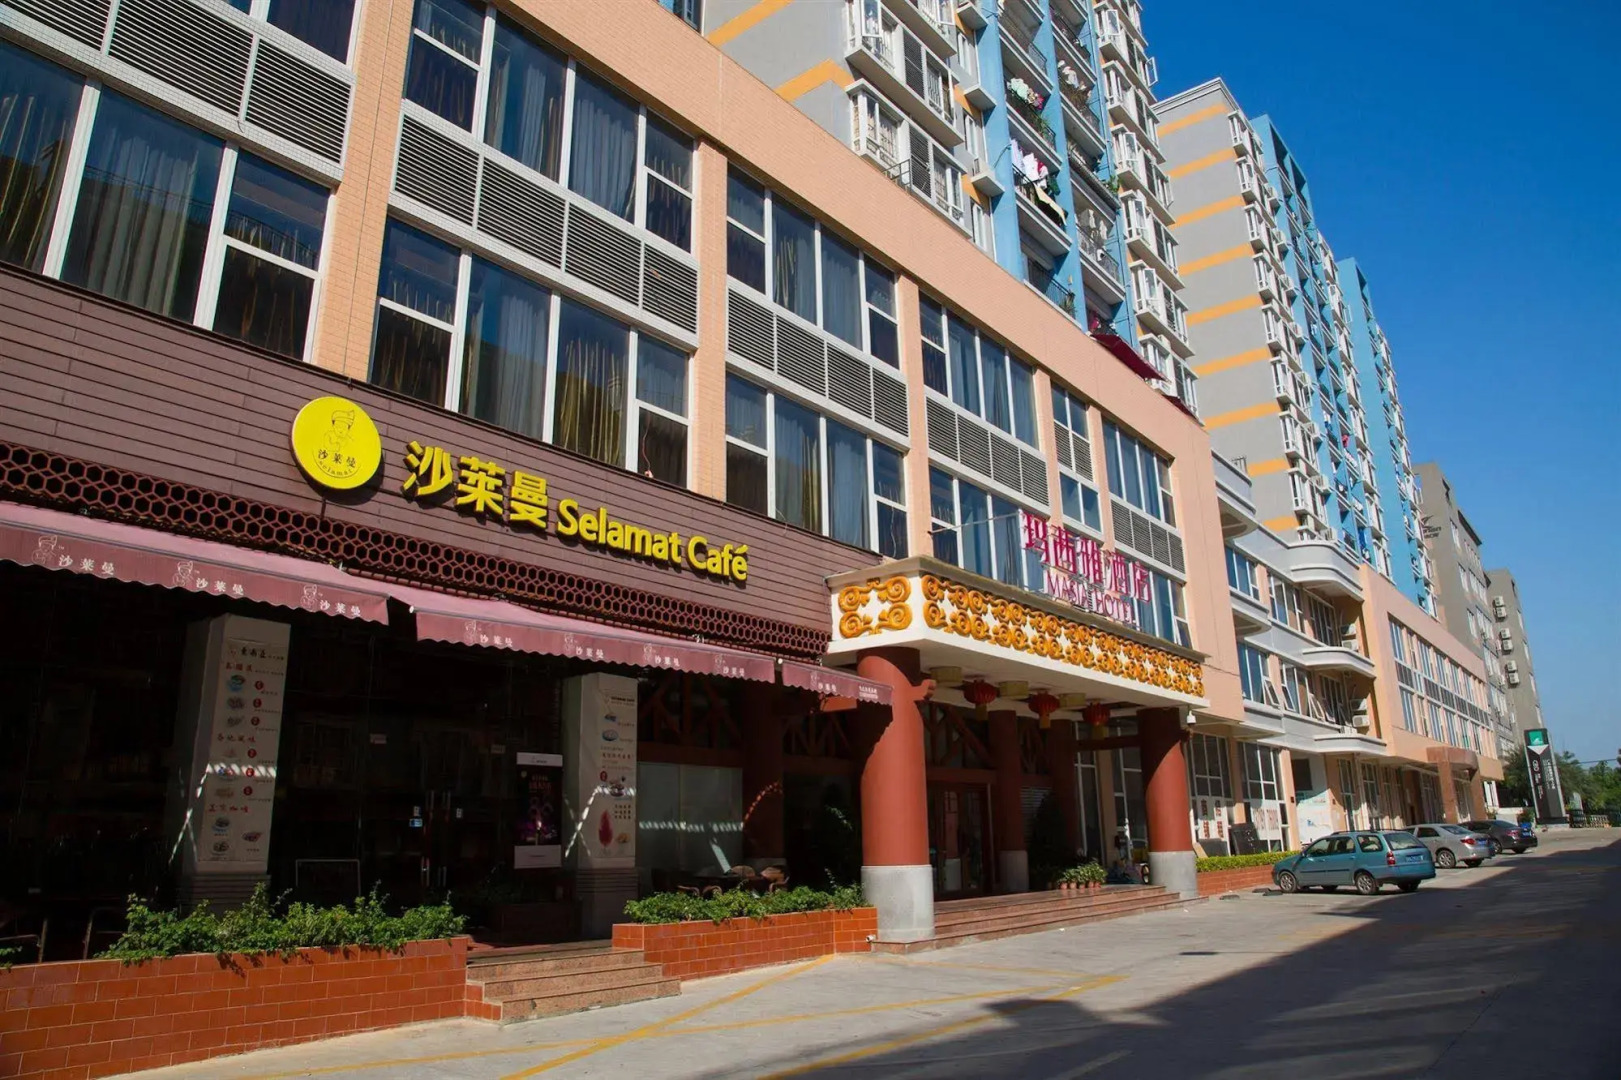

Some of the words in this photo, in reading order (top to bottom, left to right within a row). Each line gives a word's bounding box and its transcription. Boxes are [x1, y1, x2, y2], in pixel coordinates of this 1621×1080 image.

[402, 440, 549, 530] 沙莱曼
[557, 498, 684, 565] Selamat
[687, 535, 749, 580] Café
[1093, 588, 1136, 624] HOTEL
